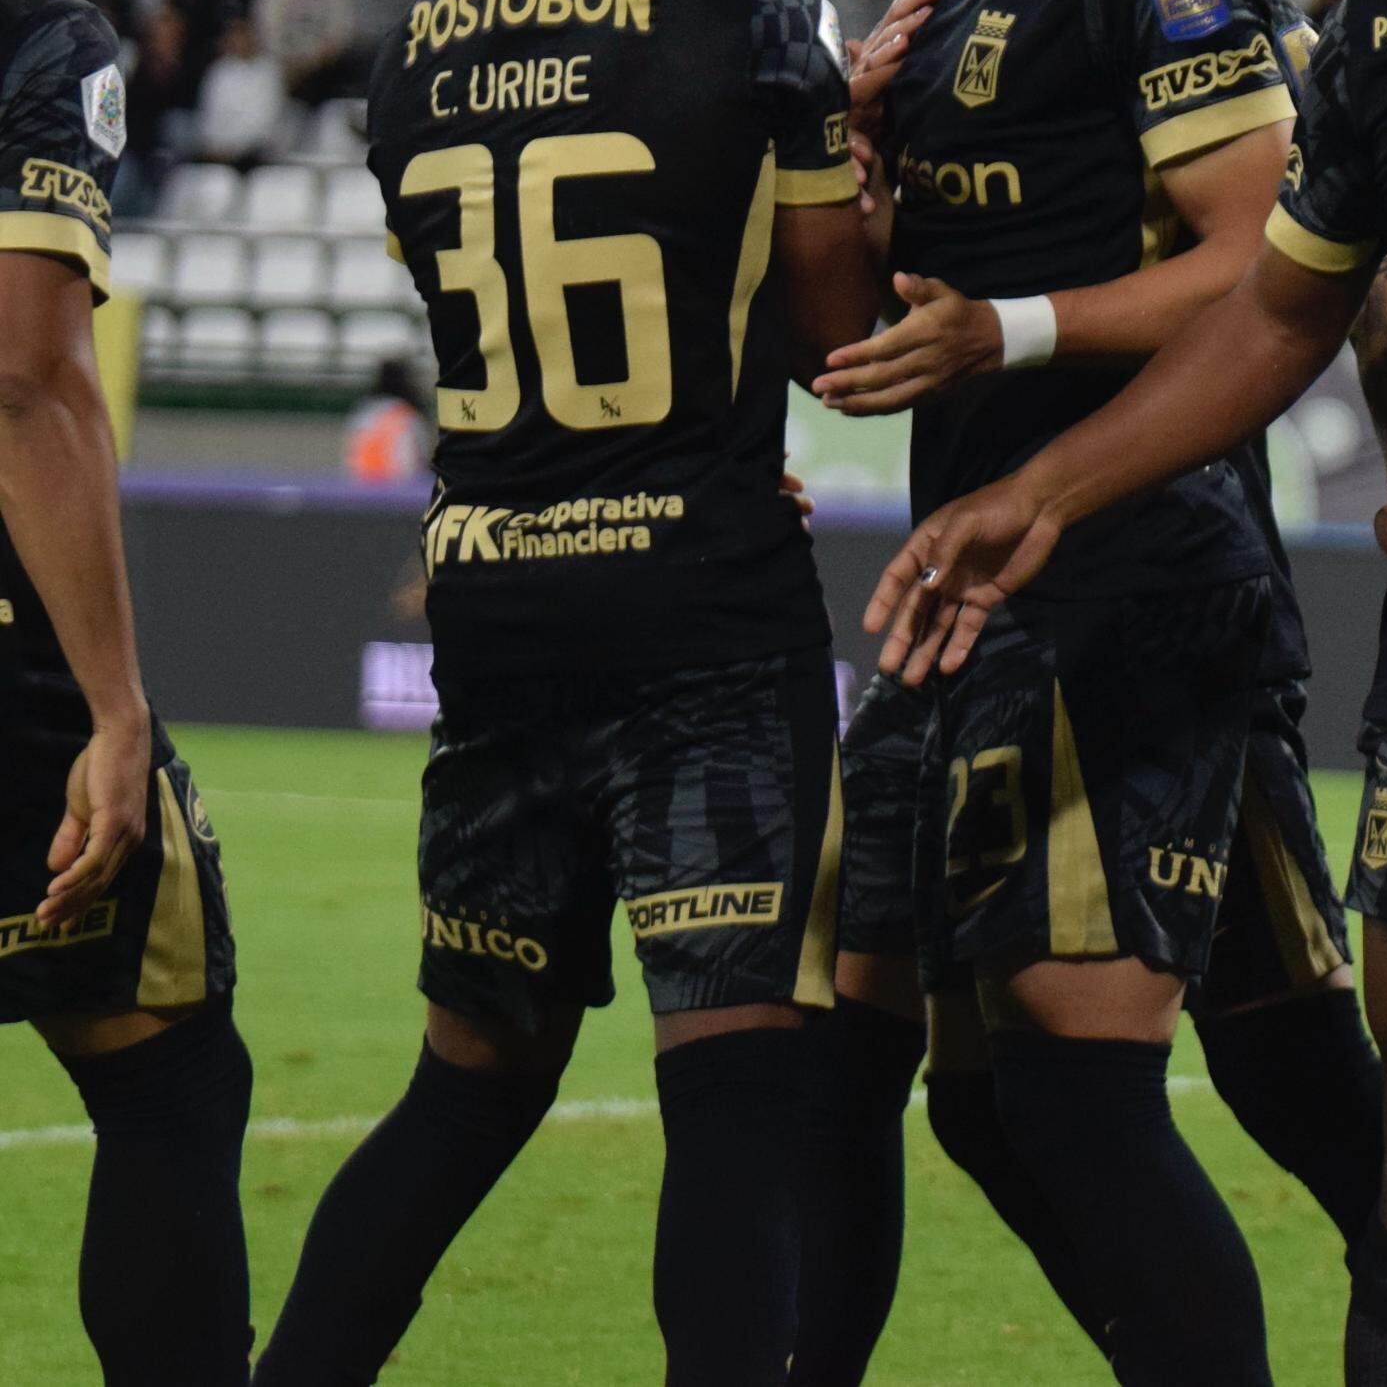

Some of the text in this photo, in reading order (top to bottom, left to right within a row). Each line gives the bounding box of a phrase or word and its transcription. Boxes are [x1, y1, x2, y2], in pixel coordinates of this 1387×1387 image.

[430, 54, 592, 117] C. URIBE
[1144, 55, 1214, 105] TVS
[26, 161, 96, 209] TVS
[399, 131, 673, 432] 36
[503, 522, 650, 559] Financiera
[628, 889, 775, 930] PORTLINE
